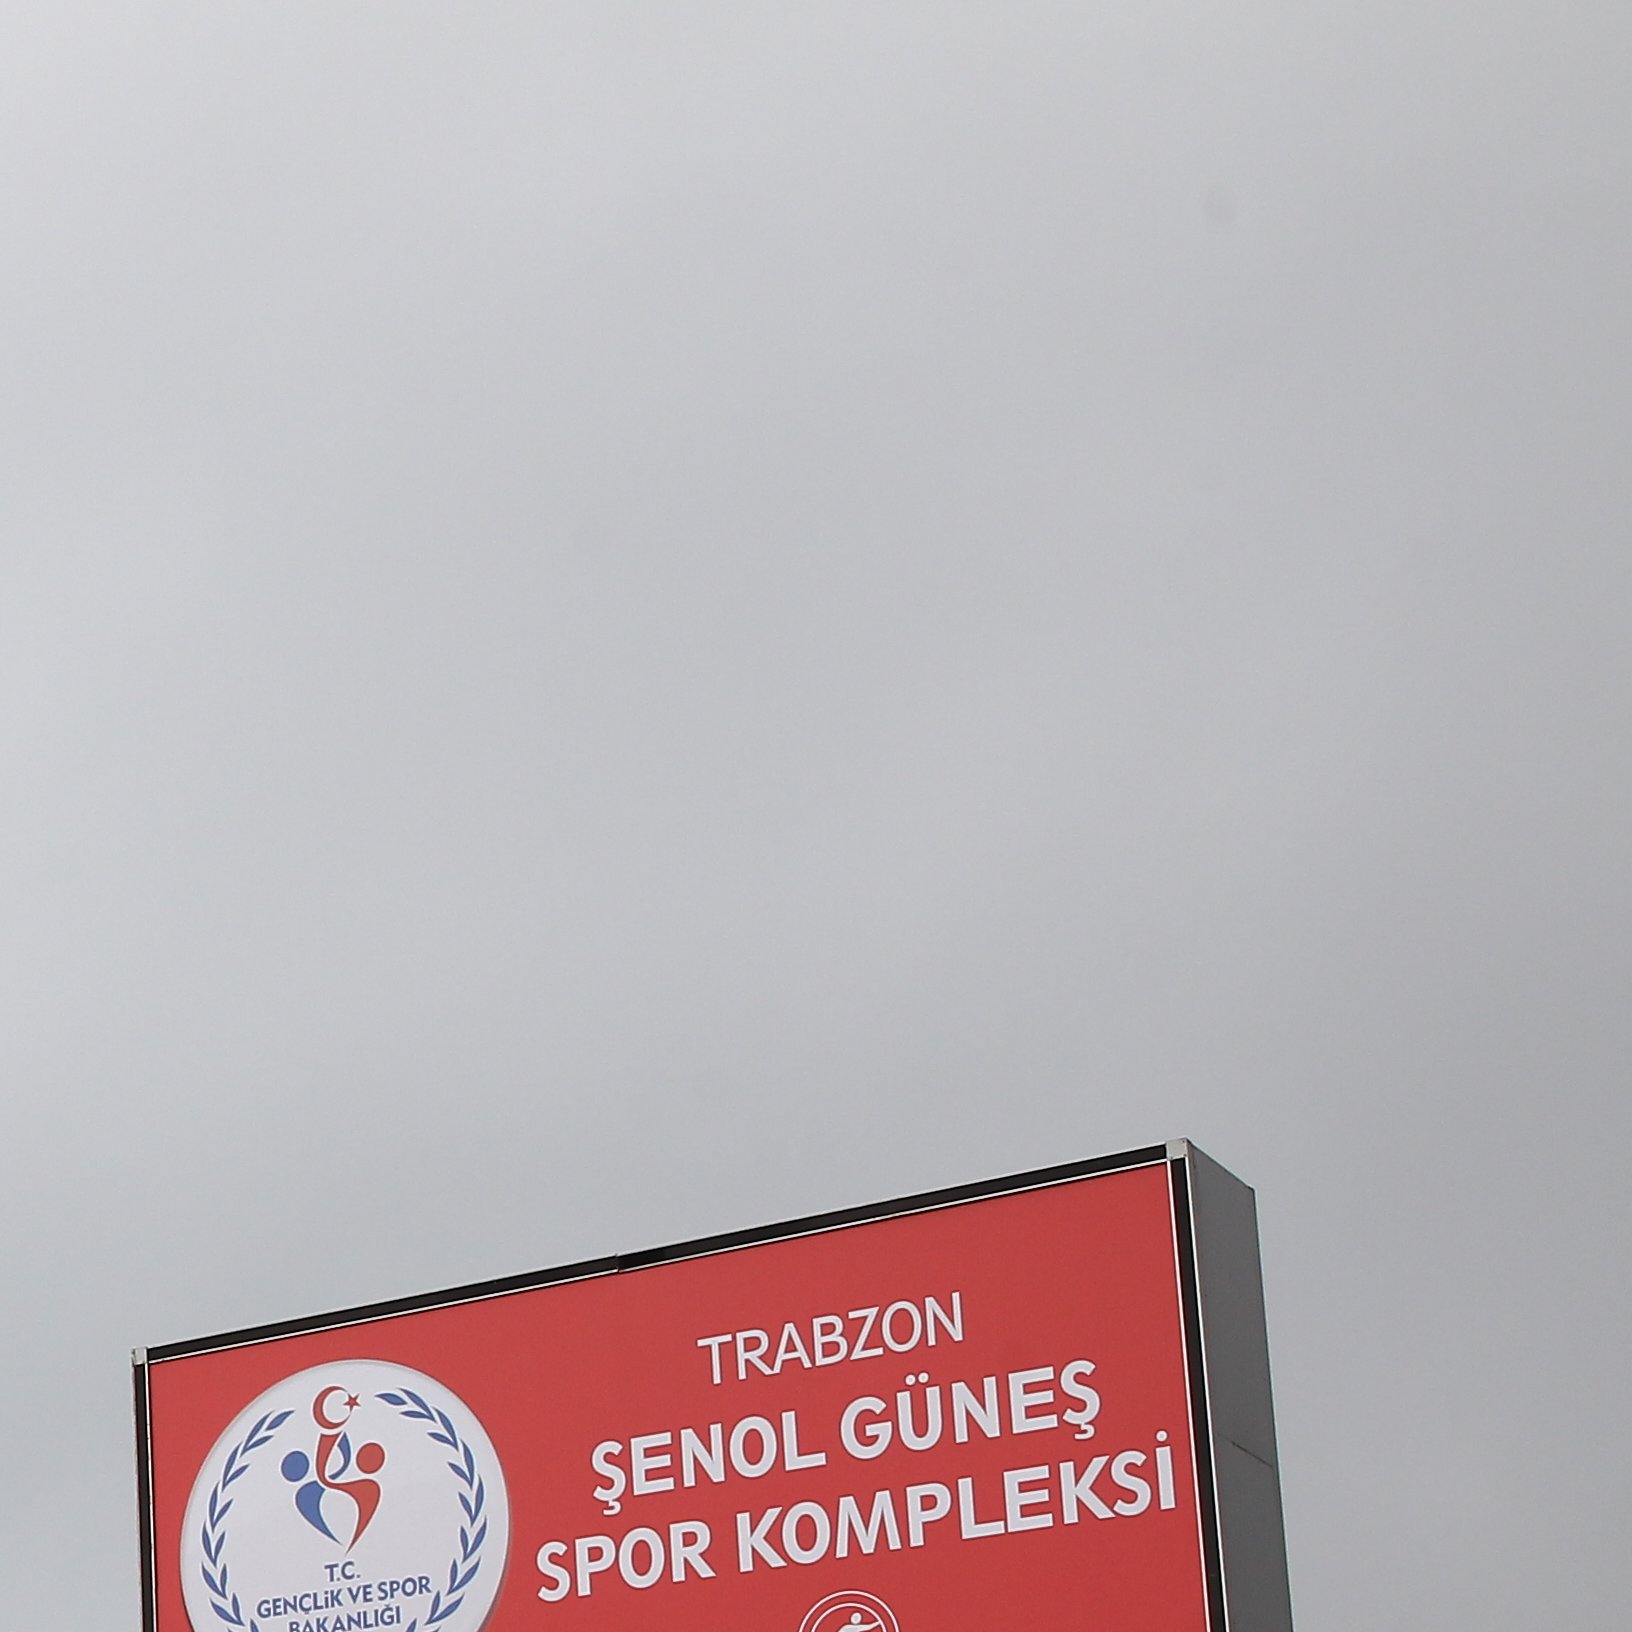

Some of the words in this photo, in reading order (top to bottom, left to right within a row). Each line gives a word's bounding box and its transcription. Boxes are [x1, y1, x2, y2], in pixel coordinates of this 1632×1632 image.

[696, 1291, 964, 1385] TRABZON
[591, 1410, 827, 1516] ŞENOL
[840, 1360, 1101, 1460] GÜNEŞ
[536, 1520, 717, 1602] SPOR
[736, 1430, 1176, 1573] KOMPLEKSİ
[324, 1561, 361, 1583] T.C.
[348, 1584, 374, 1604] VE
[377, 1576, 432, 1601] SPOR
